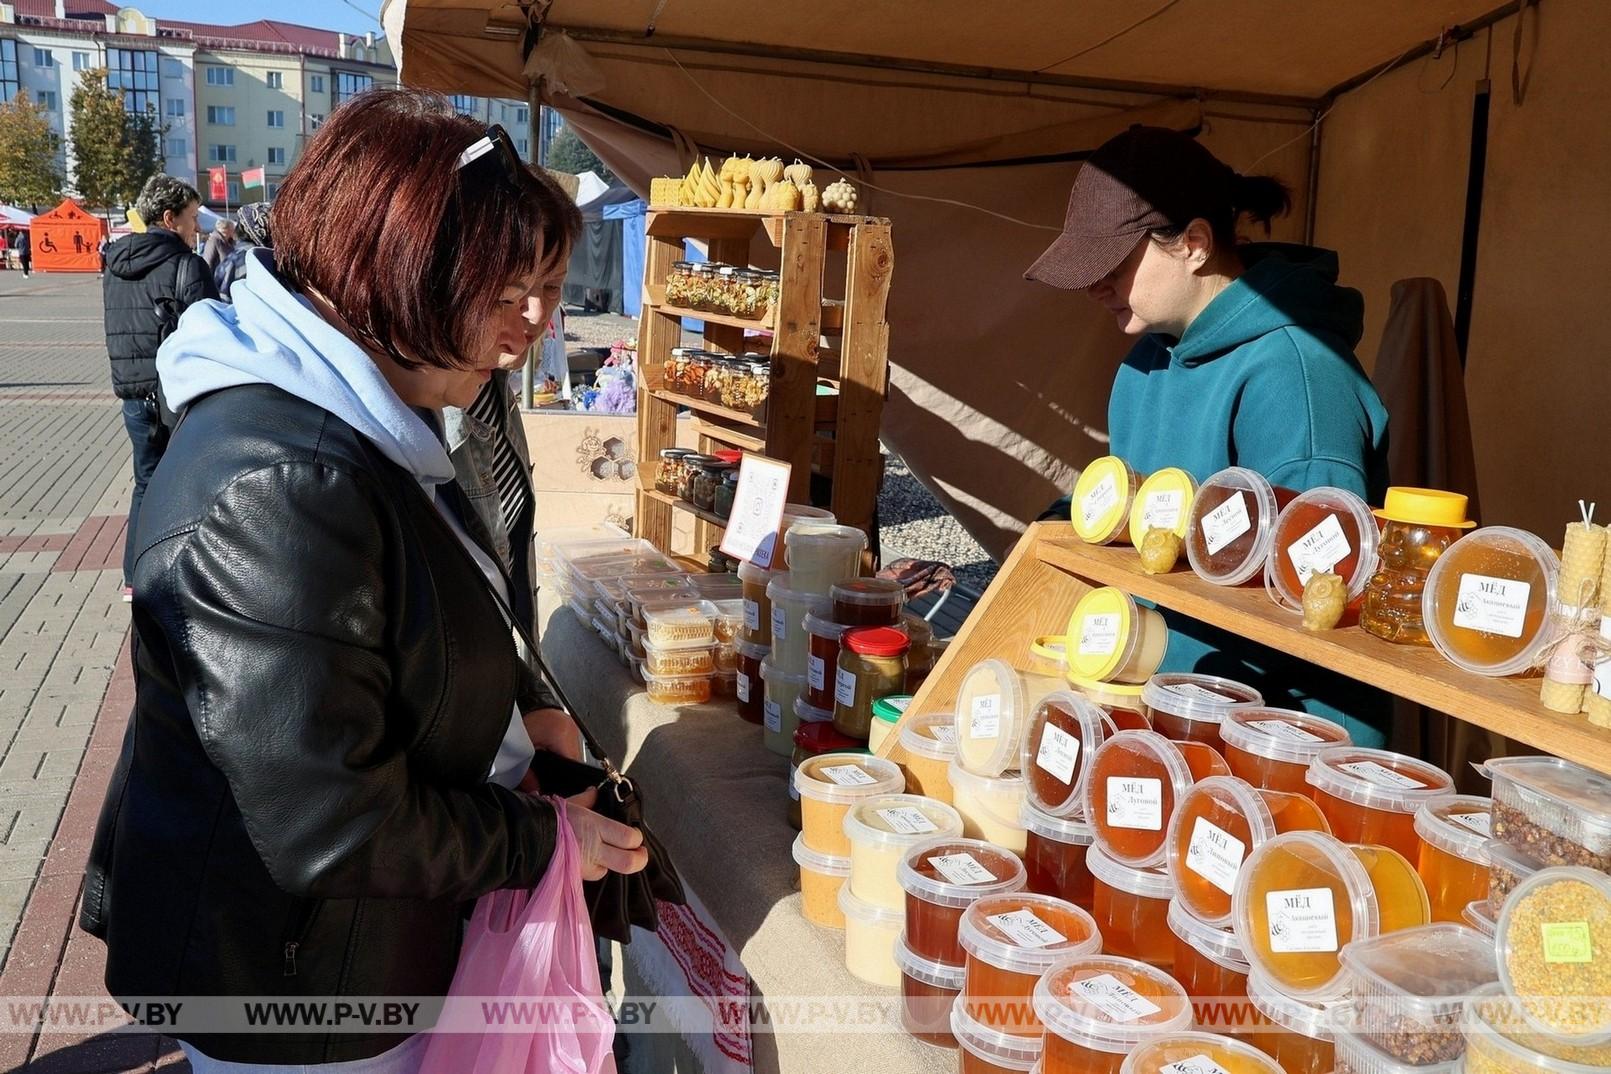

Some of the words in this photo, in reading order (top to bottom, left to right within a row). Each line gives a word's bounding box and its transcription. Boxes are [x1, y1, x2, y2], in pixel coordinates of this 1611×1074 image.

[1479, 580, 1506, 597] МЁД
[1122, 782, 1144, 794] МЁД
[1206, 829, 1229, 850] МЁД
[1284, 893, 1311, 909] МЁД
